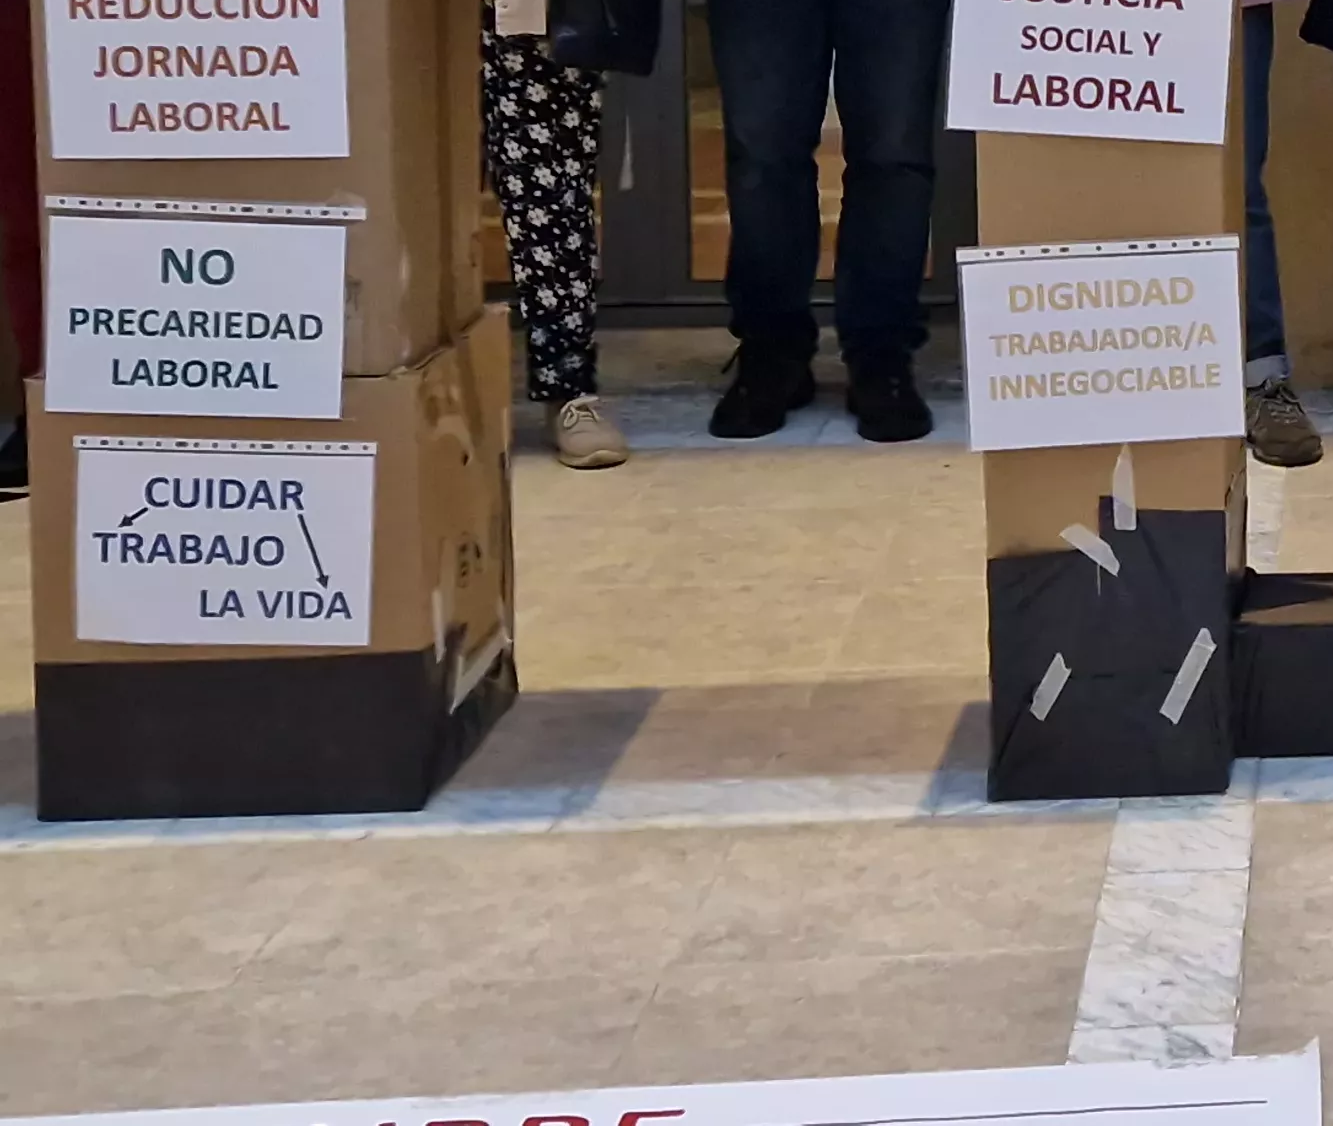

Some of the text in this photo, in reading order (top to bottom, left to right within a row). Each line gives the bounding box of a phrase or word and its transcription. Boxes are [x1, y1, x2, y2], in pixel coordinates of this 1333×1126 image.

[1020, 25, 1162, 57] SOCIAL Y
[93, 45, 300, 78] JORNADA
[993, 72, 1185, 114] LABORAL
[109, 101, 291, 133] LABORAL
[161, 247, 235, 286] NO
[1008, 276, 1195, 314] DIGNIDAD
[69, 307, 323, 341] PRECARIEDAD
[988, 321, 1217, 358] TRABAJADOR/A
[111, 358, 279, 390] LABORAL
[989, 363, 1221, 401] INNEGOCIABLE
[144, 476, 305, 511] CUIDAR
[92, 532, 285, 567] TRABAJO
[199, 589, 353, 620] LA VIDA
